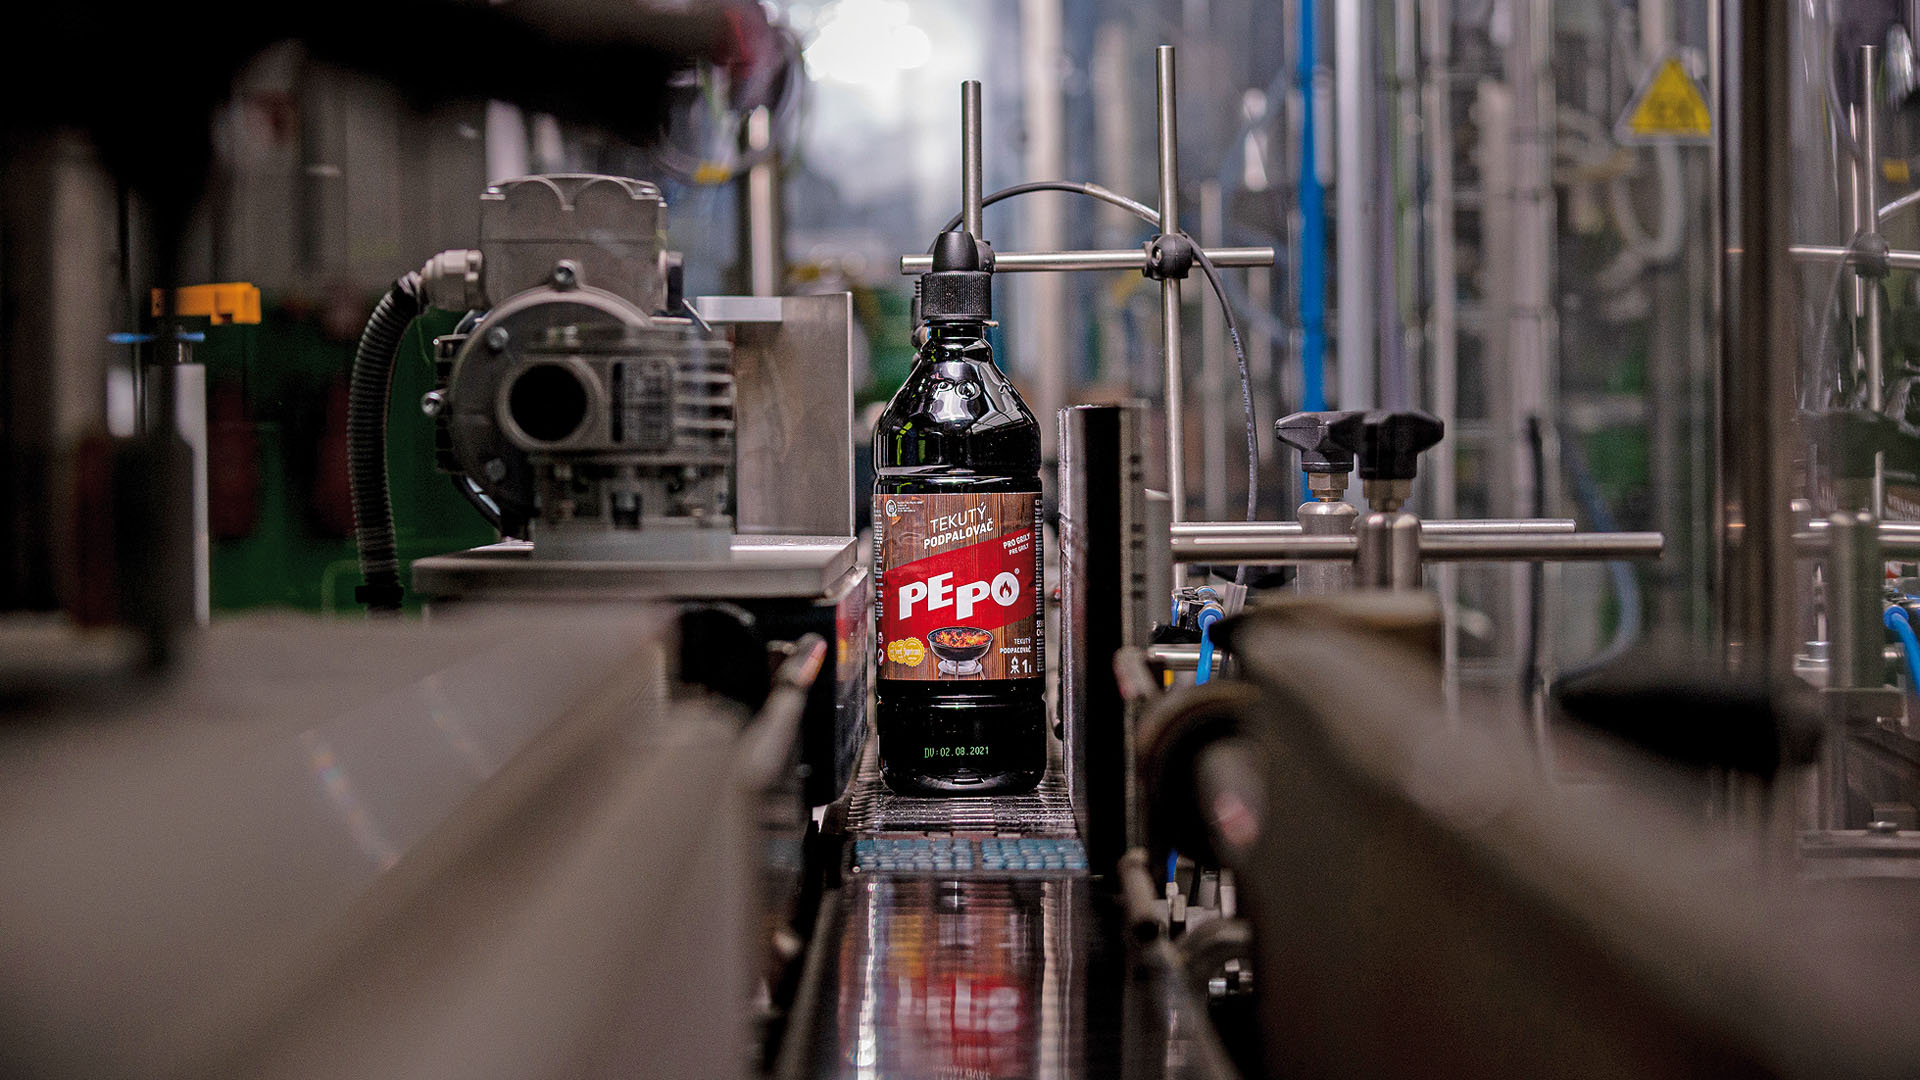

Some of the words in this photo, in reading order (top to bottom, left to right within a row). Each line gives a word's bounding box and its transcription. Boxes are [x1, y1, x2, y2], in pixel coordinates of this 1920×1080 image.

[930, 502, 987, 533] TEKUTÝ
[923, 518, 994, 550] PODPALOVAČ
[1003, 538, 1016, 549] PRO
[899, 572, 1020, 620] PEPO
